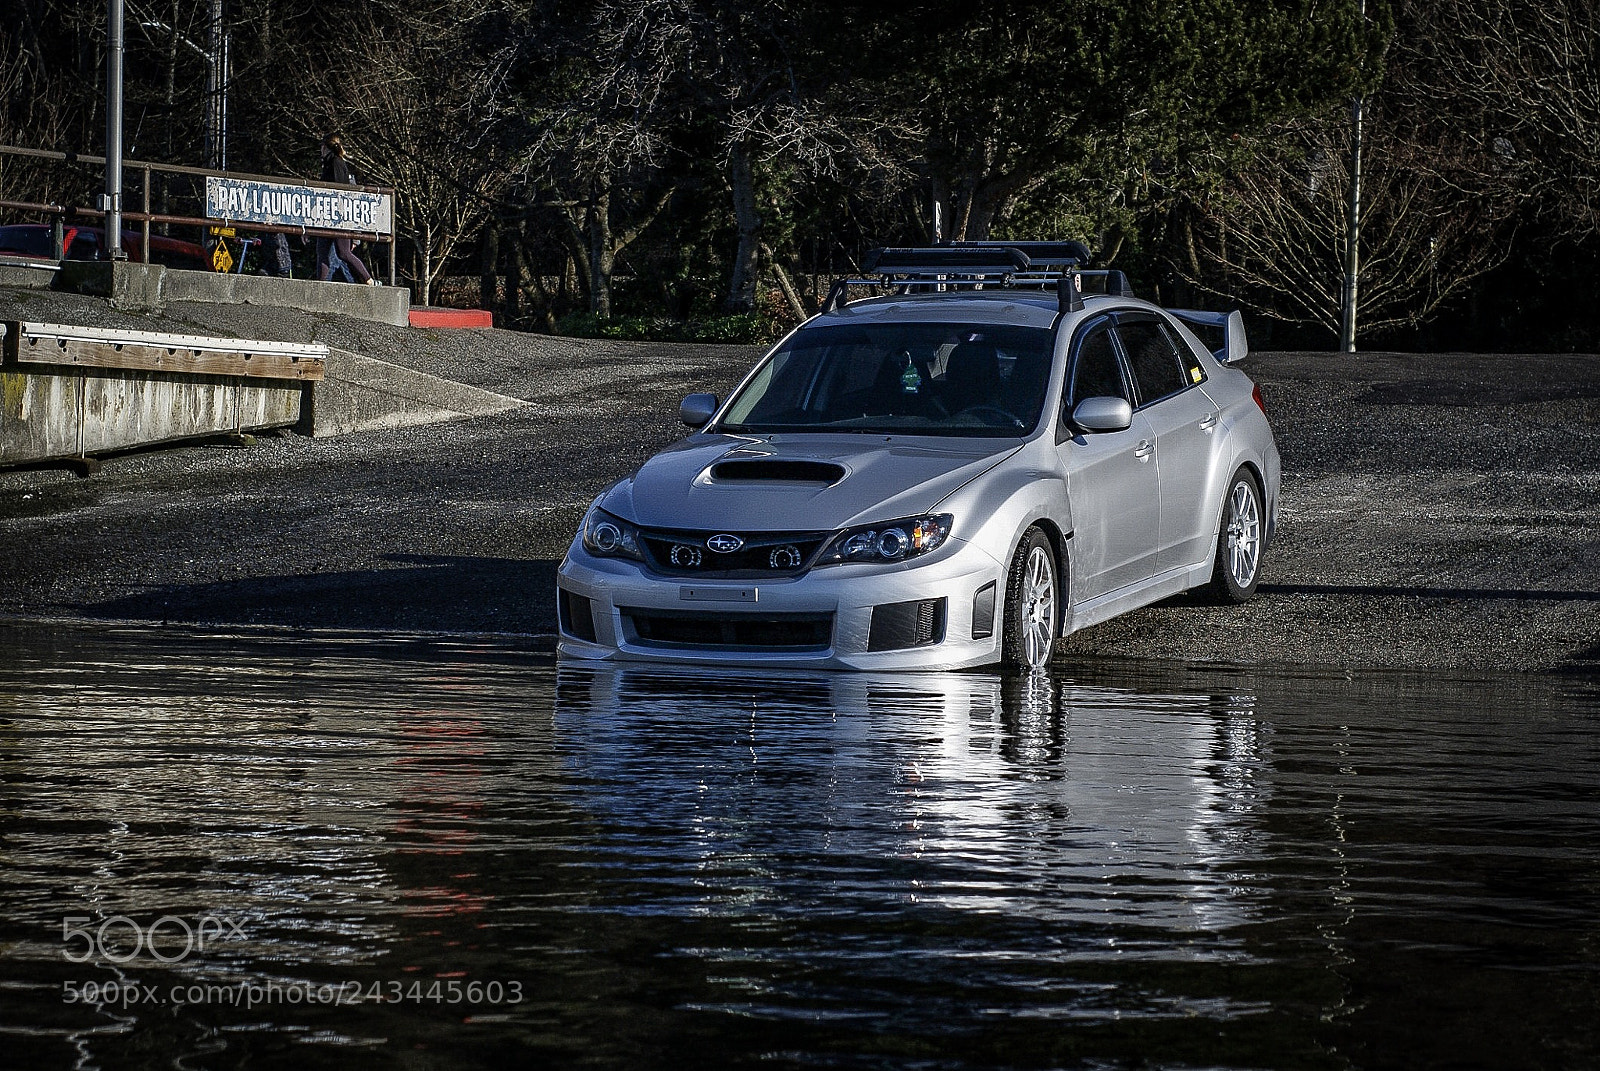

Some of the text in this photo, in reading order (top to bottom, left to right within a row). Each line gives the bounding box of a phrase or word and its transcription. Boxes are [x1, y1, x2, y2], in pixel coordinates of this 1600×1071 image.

[219, 186, 377, 224] PAY LAUNCH FEE HERE
